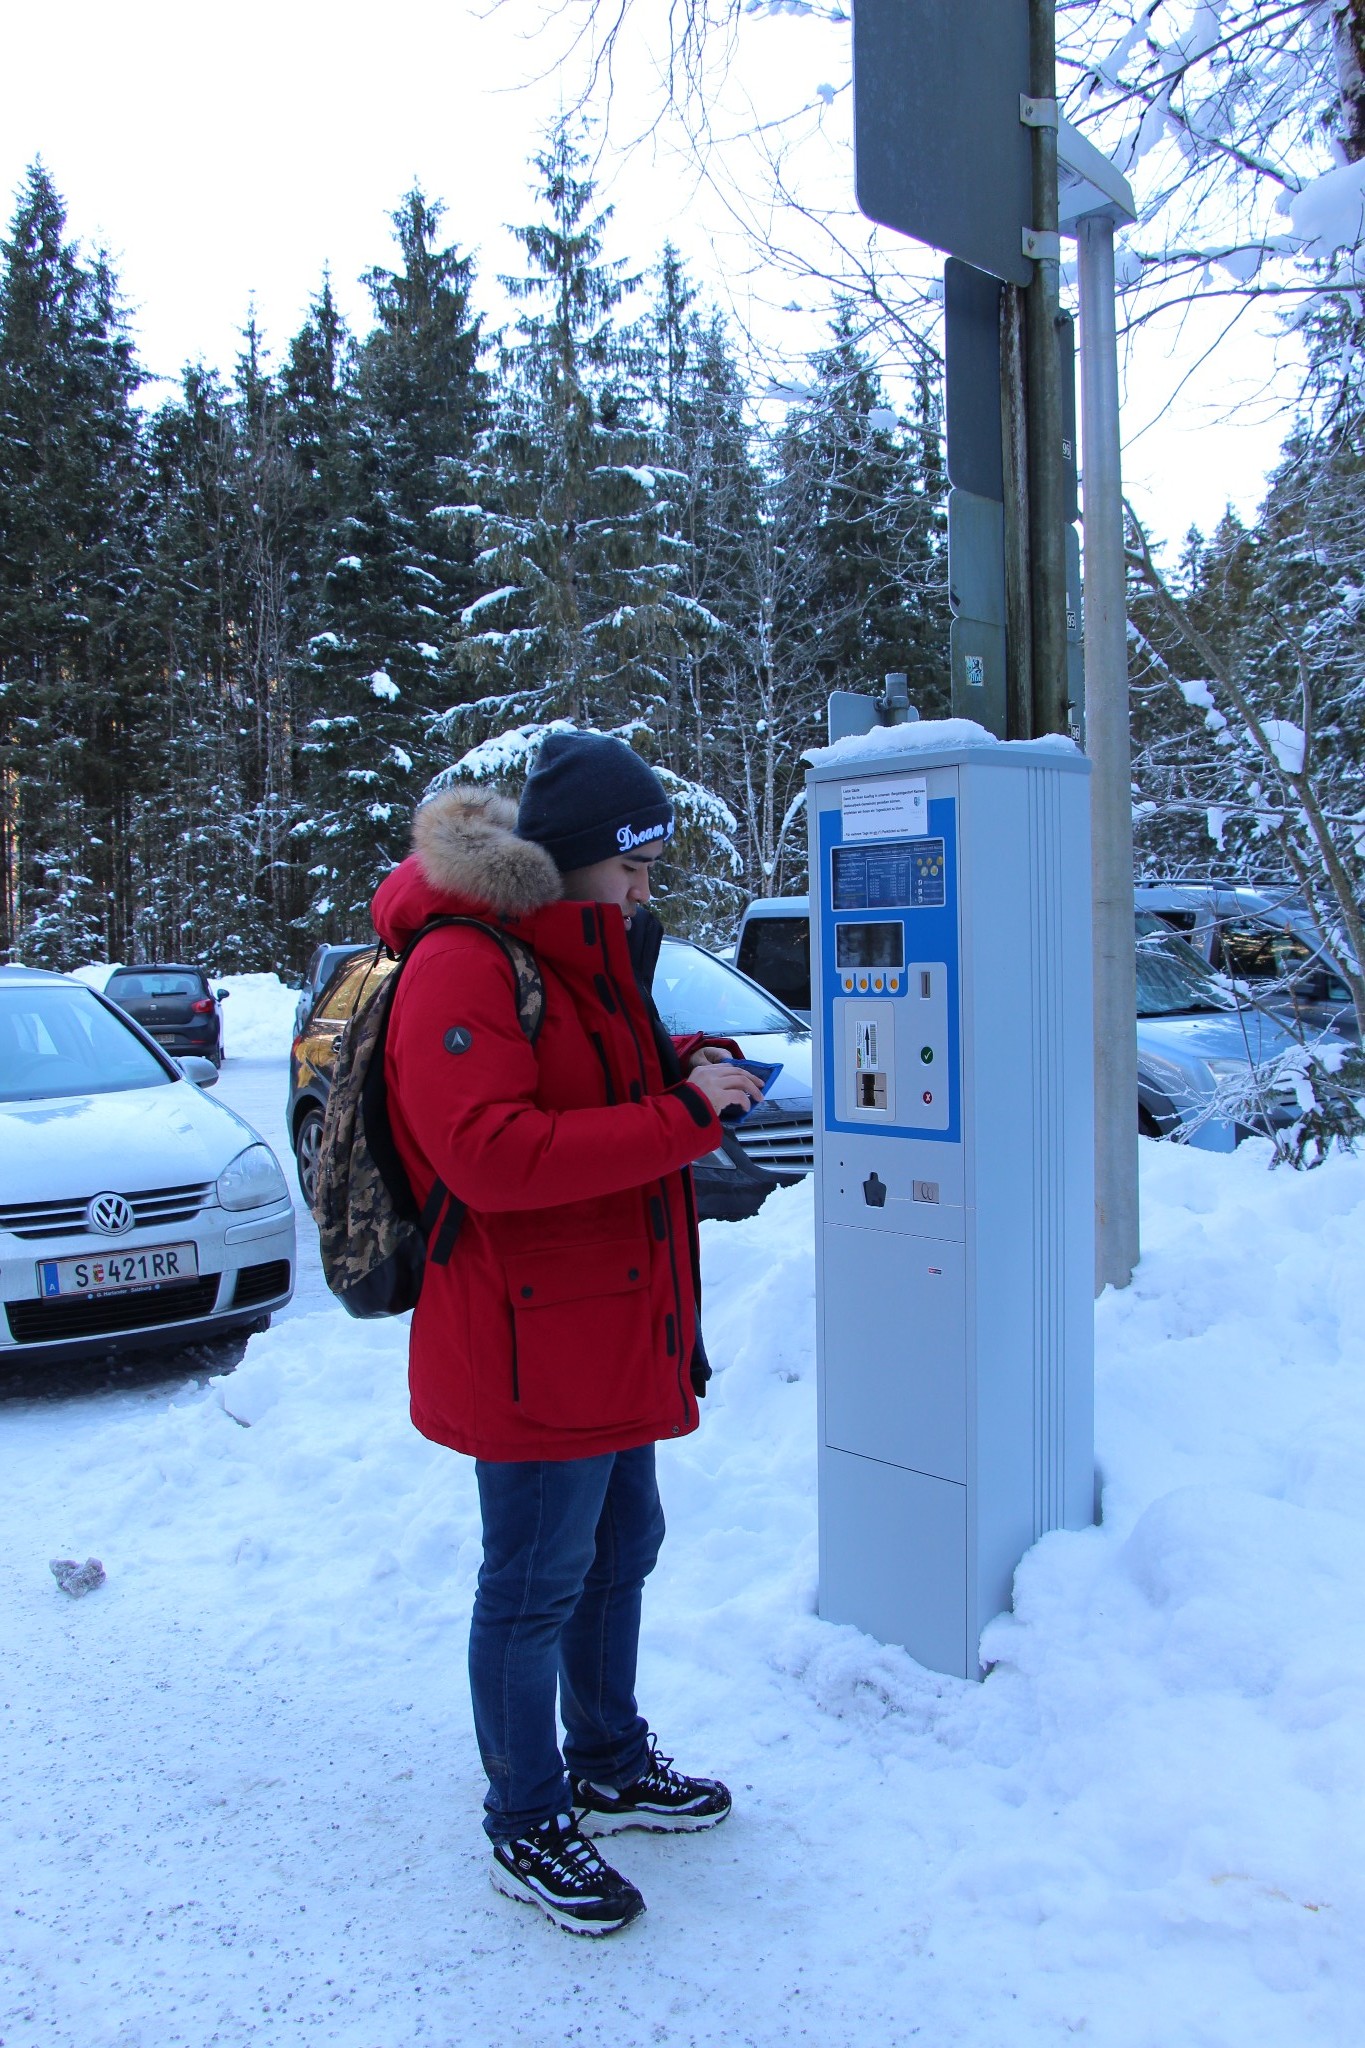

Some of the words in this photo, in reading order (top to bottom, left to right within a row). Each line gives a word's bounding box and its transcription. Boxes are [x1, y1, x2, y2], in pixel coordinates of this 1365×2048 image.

[617, 824, 664, 851] Dream
[95, 1196, 129, 1231] VW
[49, 1283, 56, 1291] A
[75, 1264, 89, 1288] S
